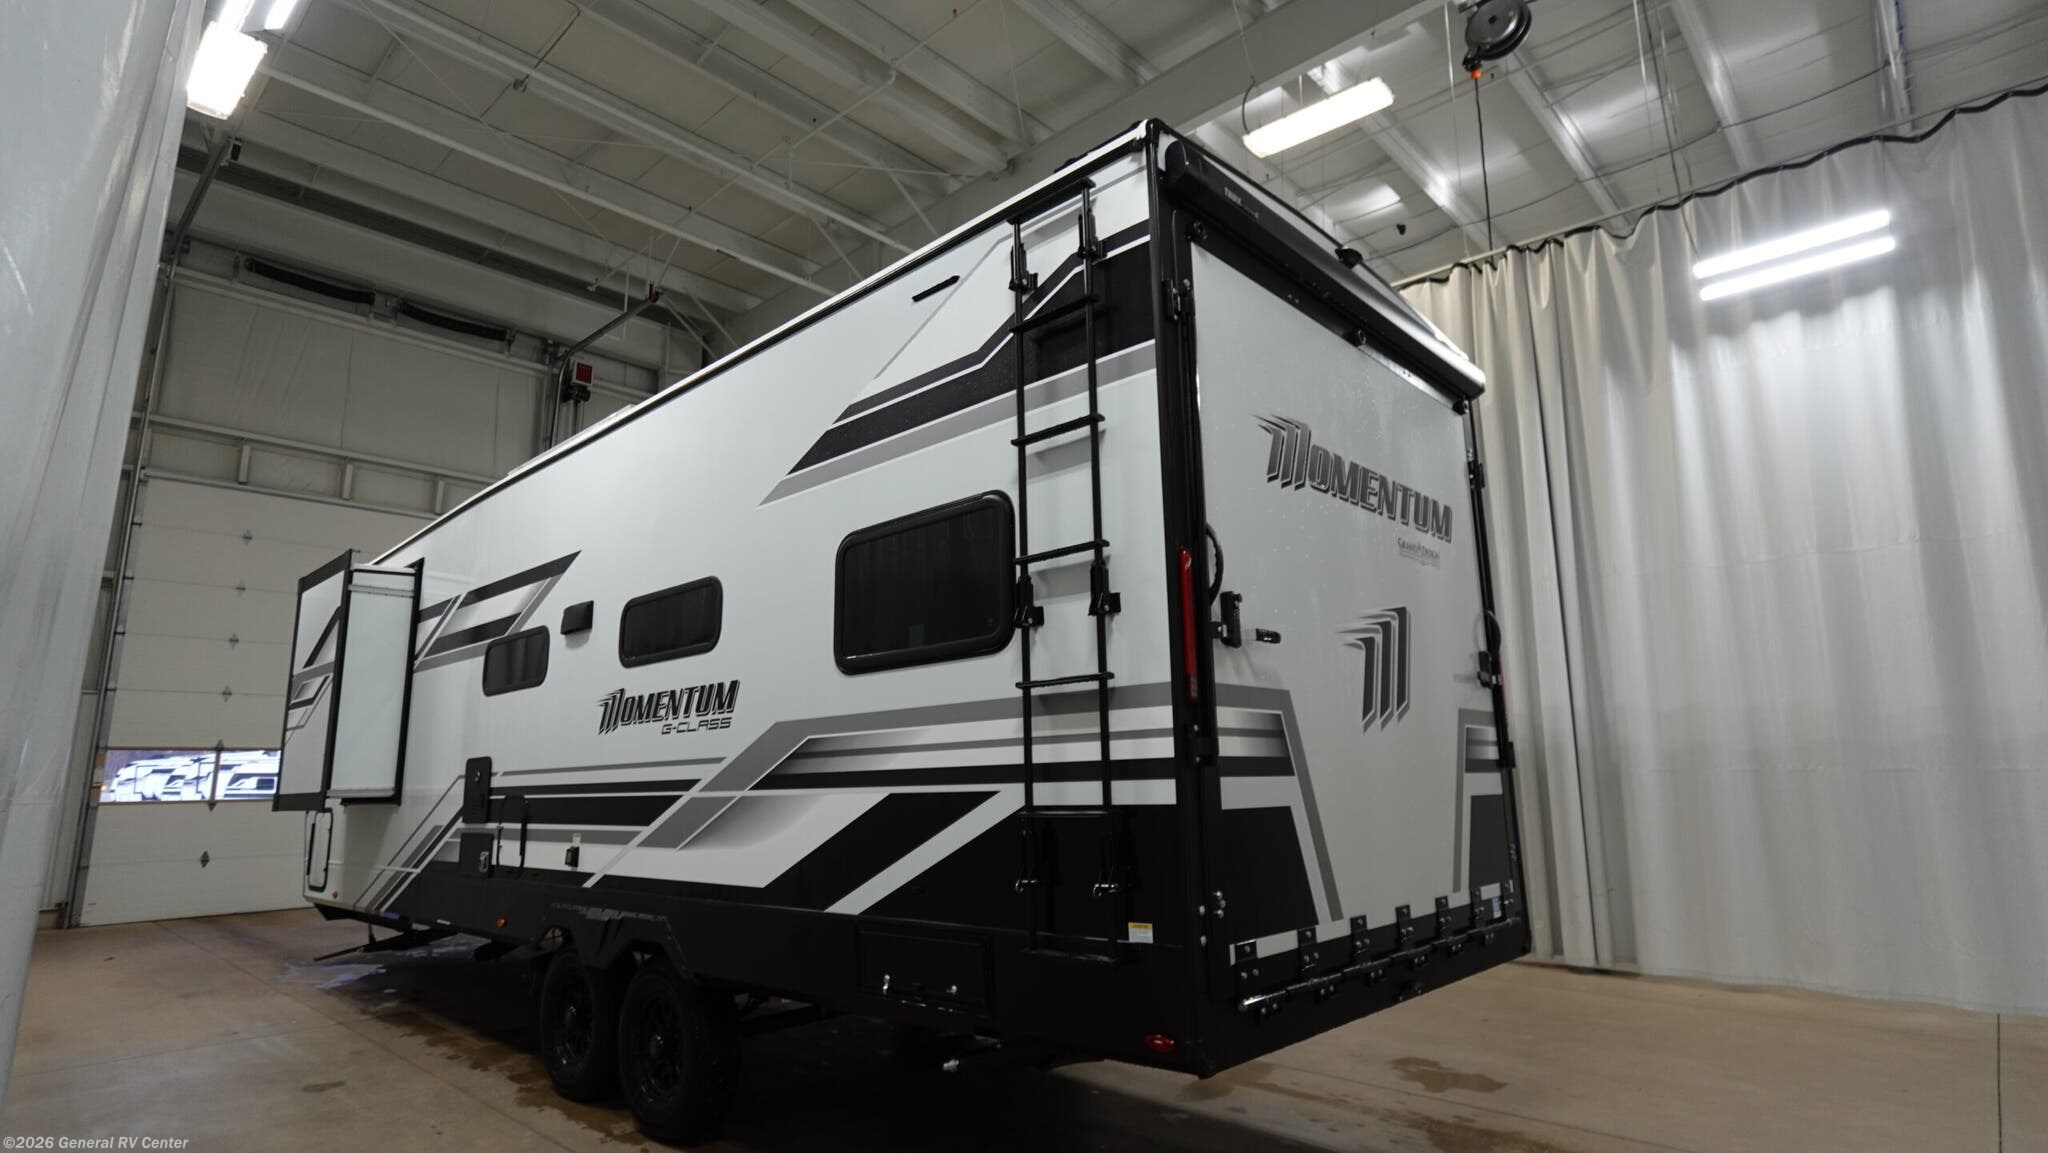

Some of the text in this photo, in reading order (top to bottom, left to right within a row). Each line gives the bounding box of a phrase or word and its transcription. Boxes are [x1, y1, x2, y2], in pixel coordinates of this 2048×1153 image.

[1250, 413, 1453, 543] MOMENTUM
[597, 679, 740, 735] MOMENTUM
[661, 717, 732, 735] G-CLASS
